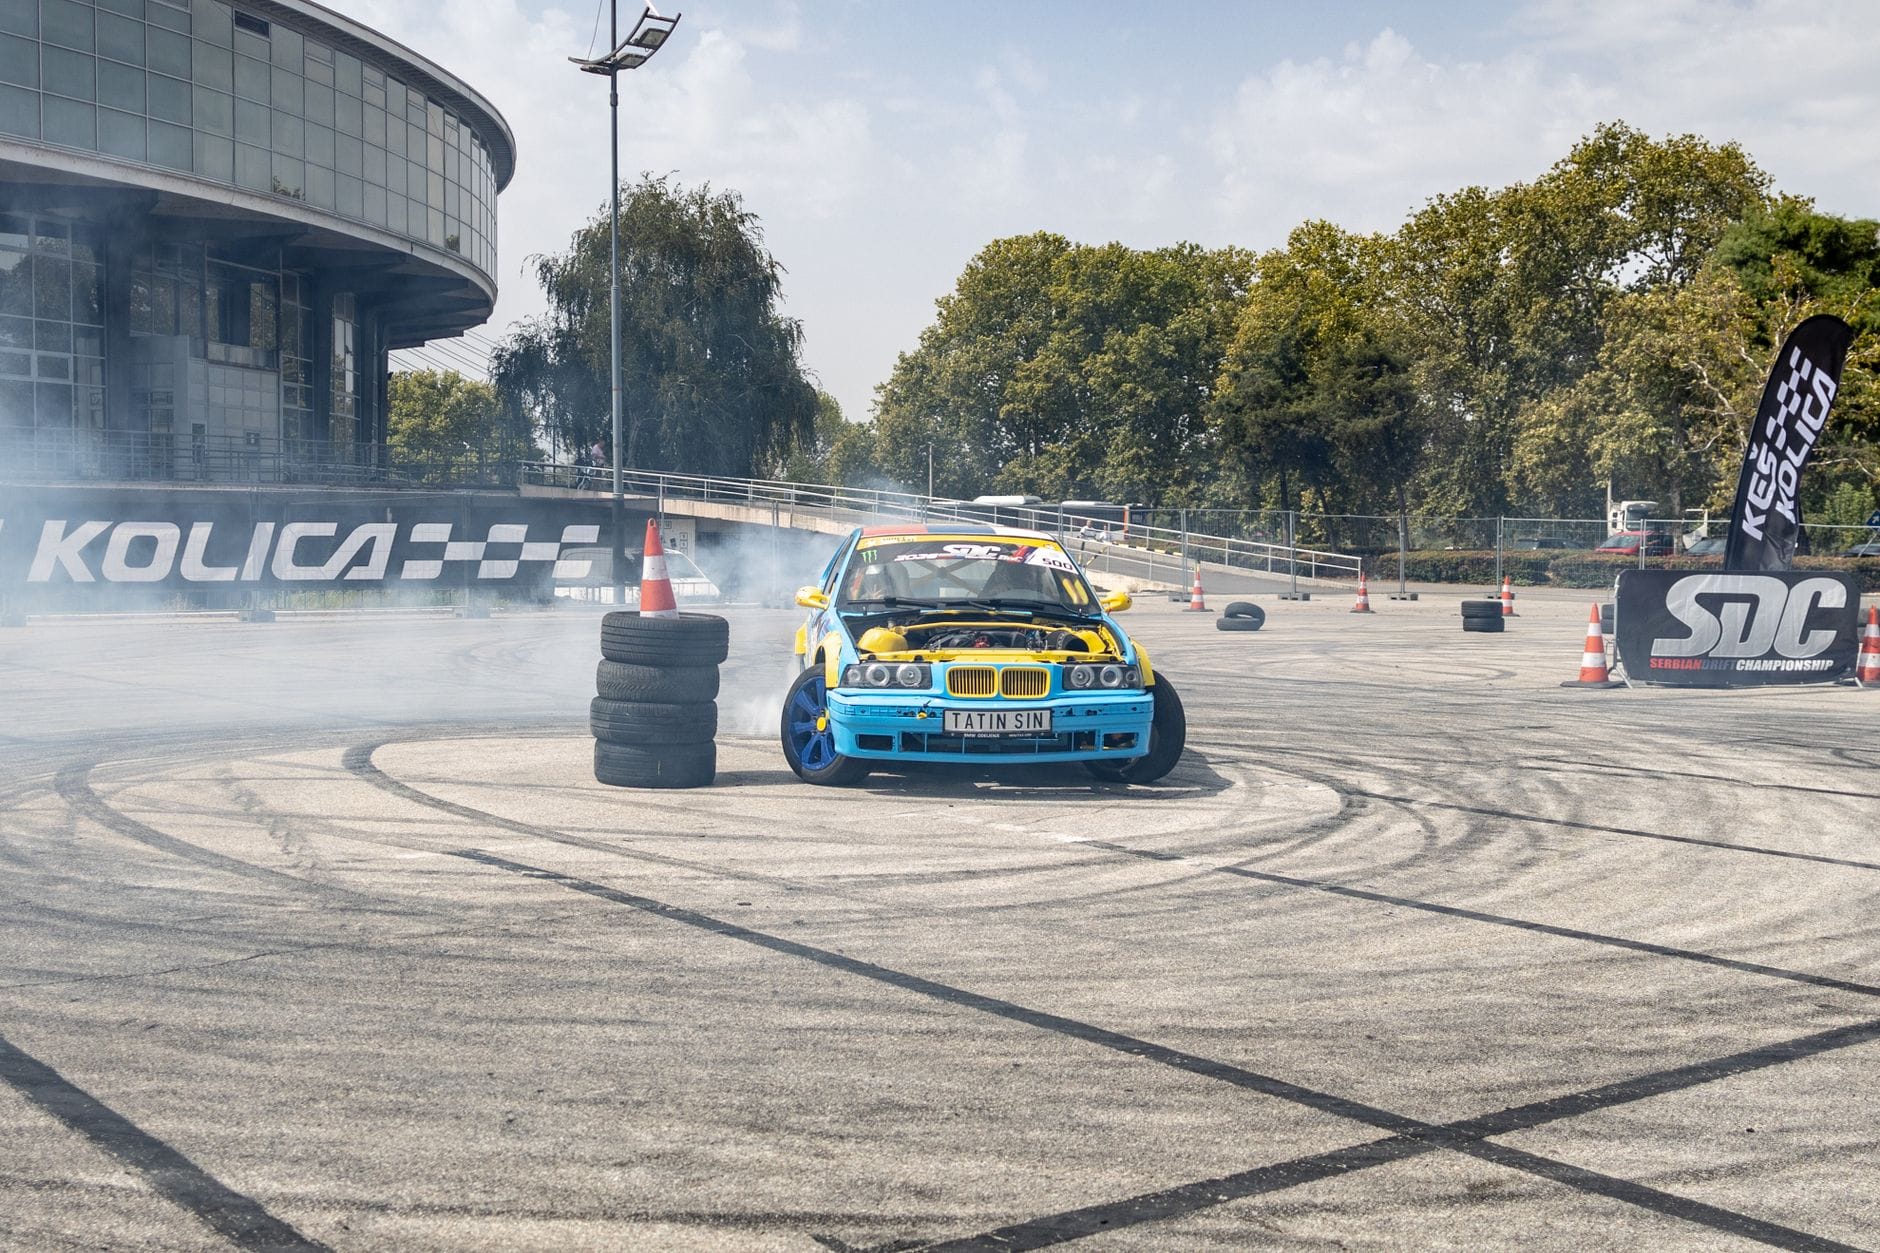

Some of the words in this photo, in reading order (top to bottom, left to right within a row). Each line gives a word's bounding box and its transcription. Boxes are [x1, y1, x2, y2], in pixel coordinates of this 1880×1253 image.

[1776, 367, 1837, 524] KOLICA
[1742, 442, 1777, 541] KEŠ
[26, 520, 398, 582] KOLICA
[943, 544, 1001, 557] SDC
[1042, 558, 1073, 570] 500
[1651, 575, 1847, 658] SDC
[1650, 658, 1702, 670] SERBIAN
[1736, 659, 1834, 671] CHAMPIONSHIP
[952, 712, 1006, 729] TATIN
[1014, 712, 1043, 729] SIN
